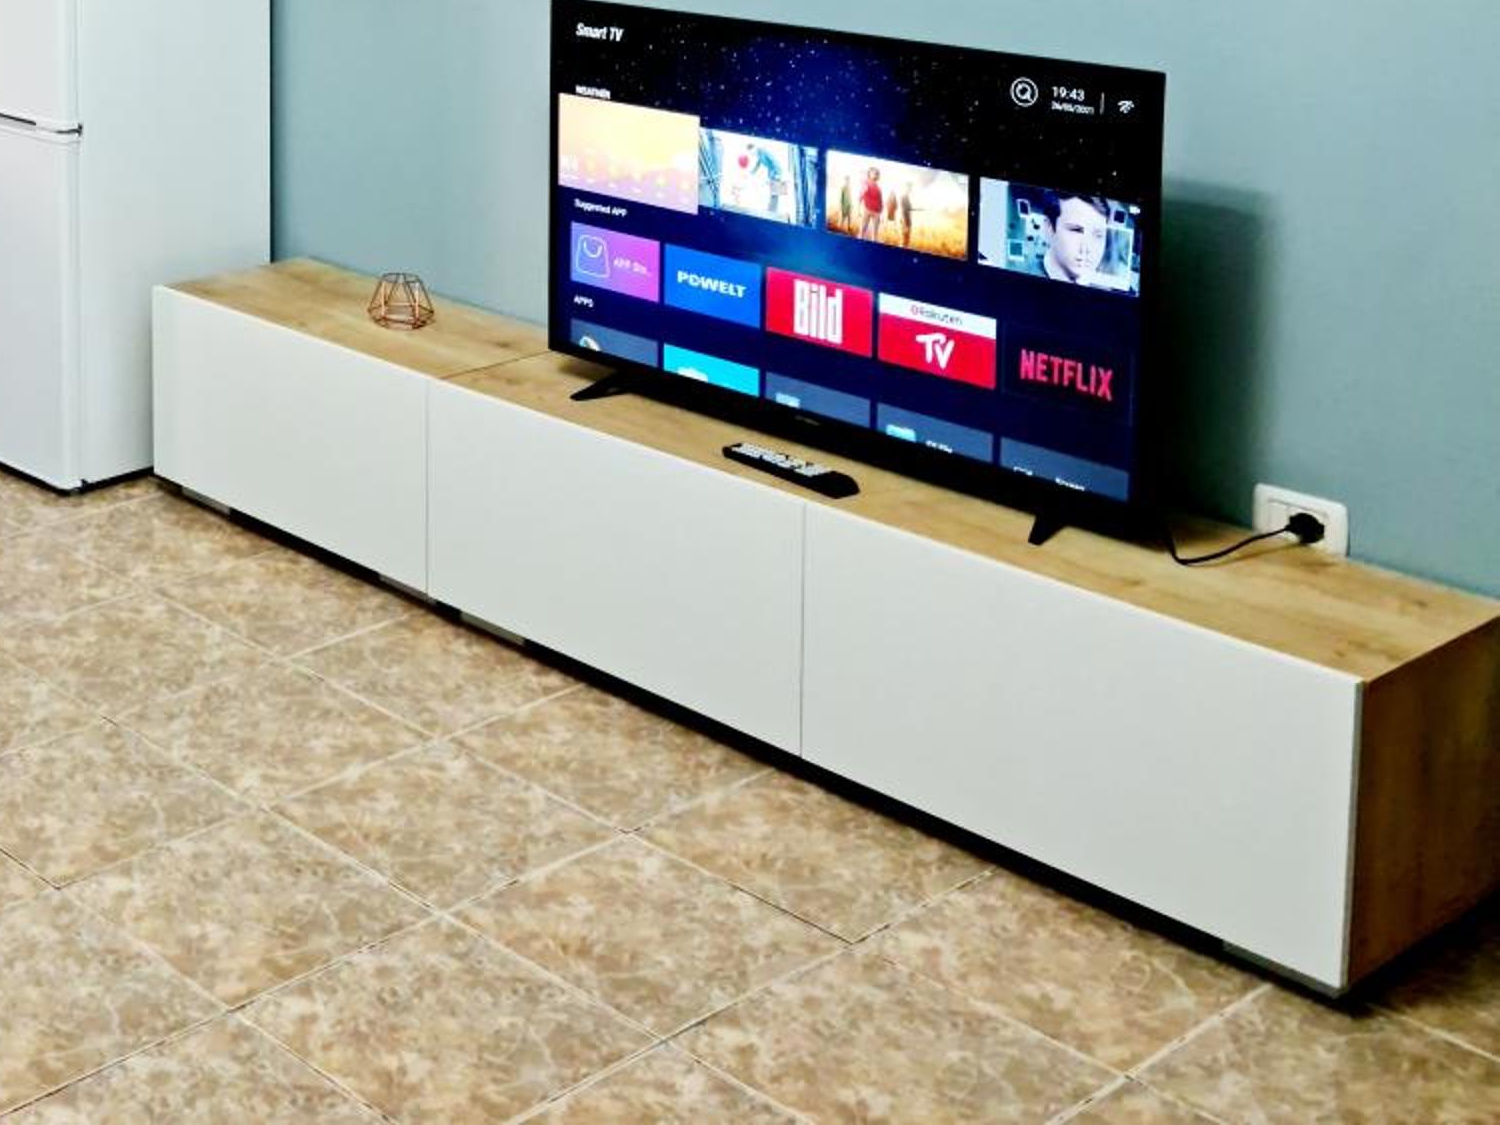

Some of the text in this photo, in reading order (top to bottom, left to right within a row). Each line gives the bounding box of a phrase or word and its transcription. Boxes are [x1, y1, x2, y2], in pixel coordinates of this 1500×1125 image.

[576, 22, 625, 42] Smart TV
[1052, 86, 1085, 102] 19:43
[793, 278, 843, 344] Bild
[915, 332, 955, 370] TV
[1019, 347, 1114, 402] NETFLIX
